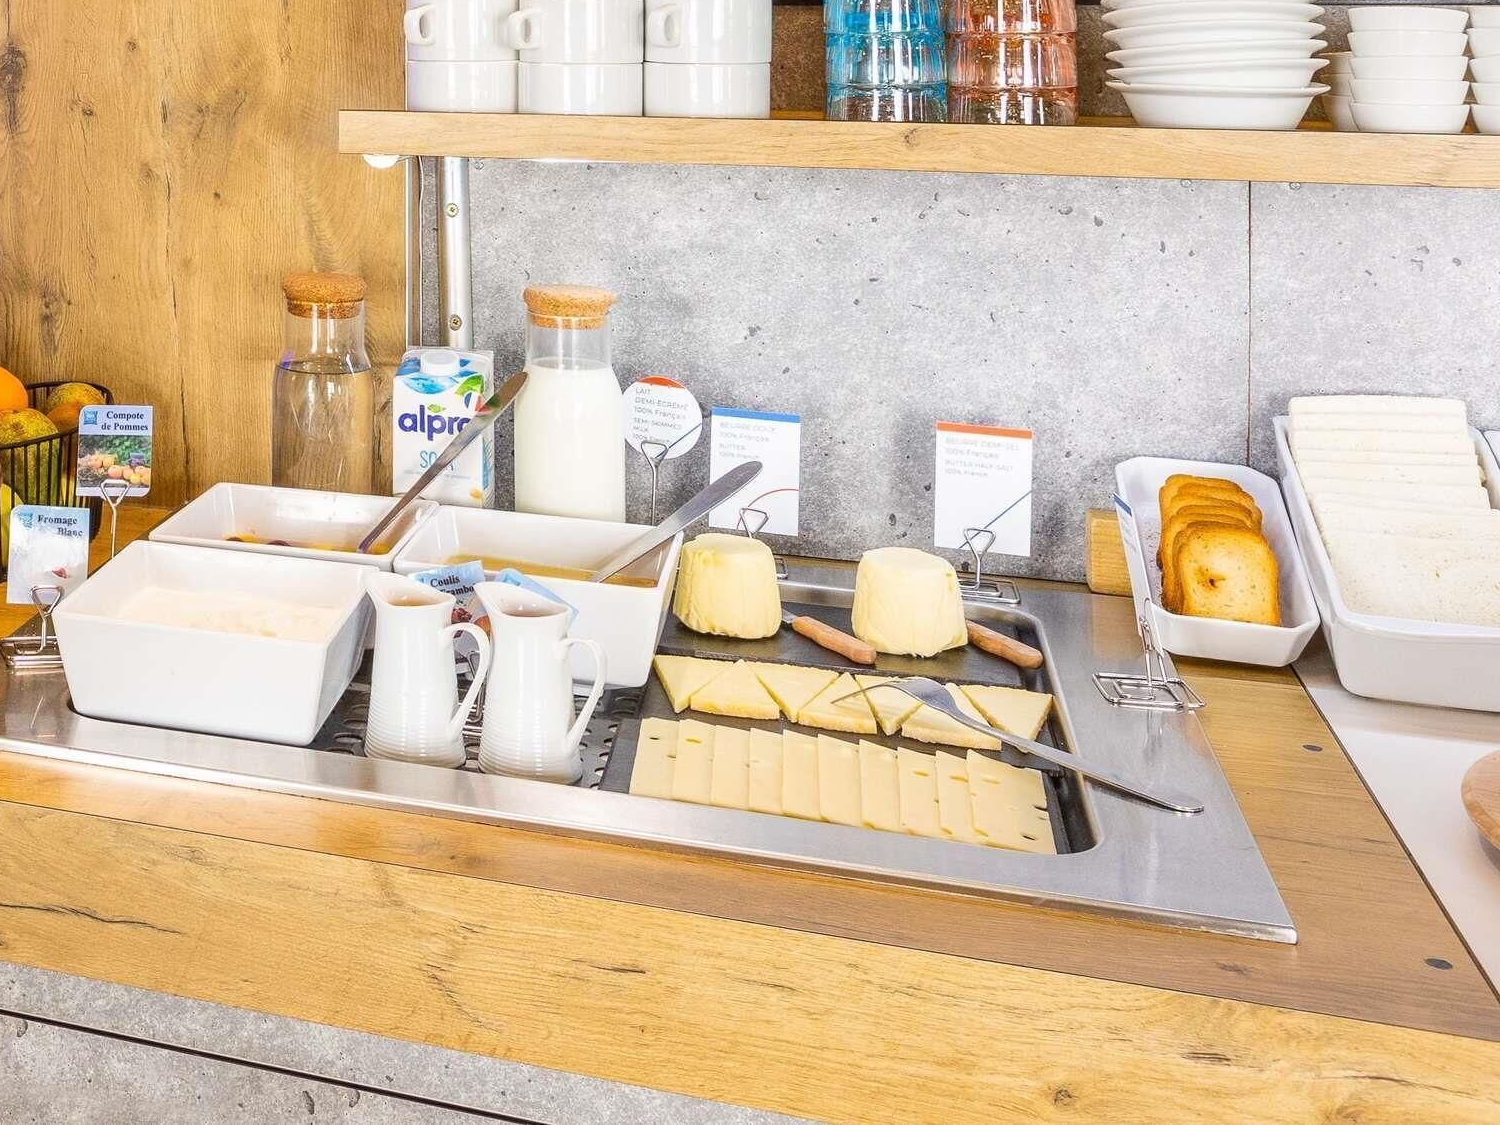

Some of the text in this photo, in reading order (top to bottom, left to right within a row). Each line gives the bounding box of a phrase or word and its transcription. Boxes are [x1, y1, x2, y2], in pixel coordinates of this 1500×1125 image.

[106, 410, 145, 421] Compote
[100, 422, 149, 431] de Pommes
[37, 514, 78, 526] Fromage
[57, 527, 83, 537] Blanc
[430, 575, 461, 588] Coulis
